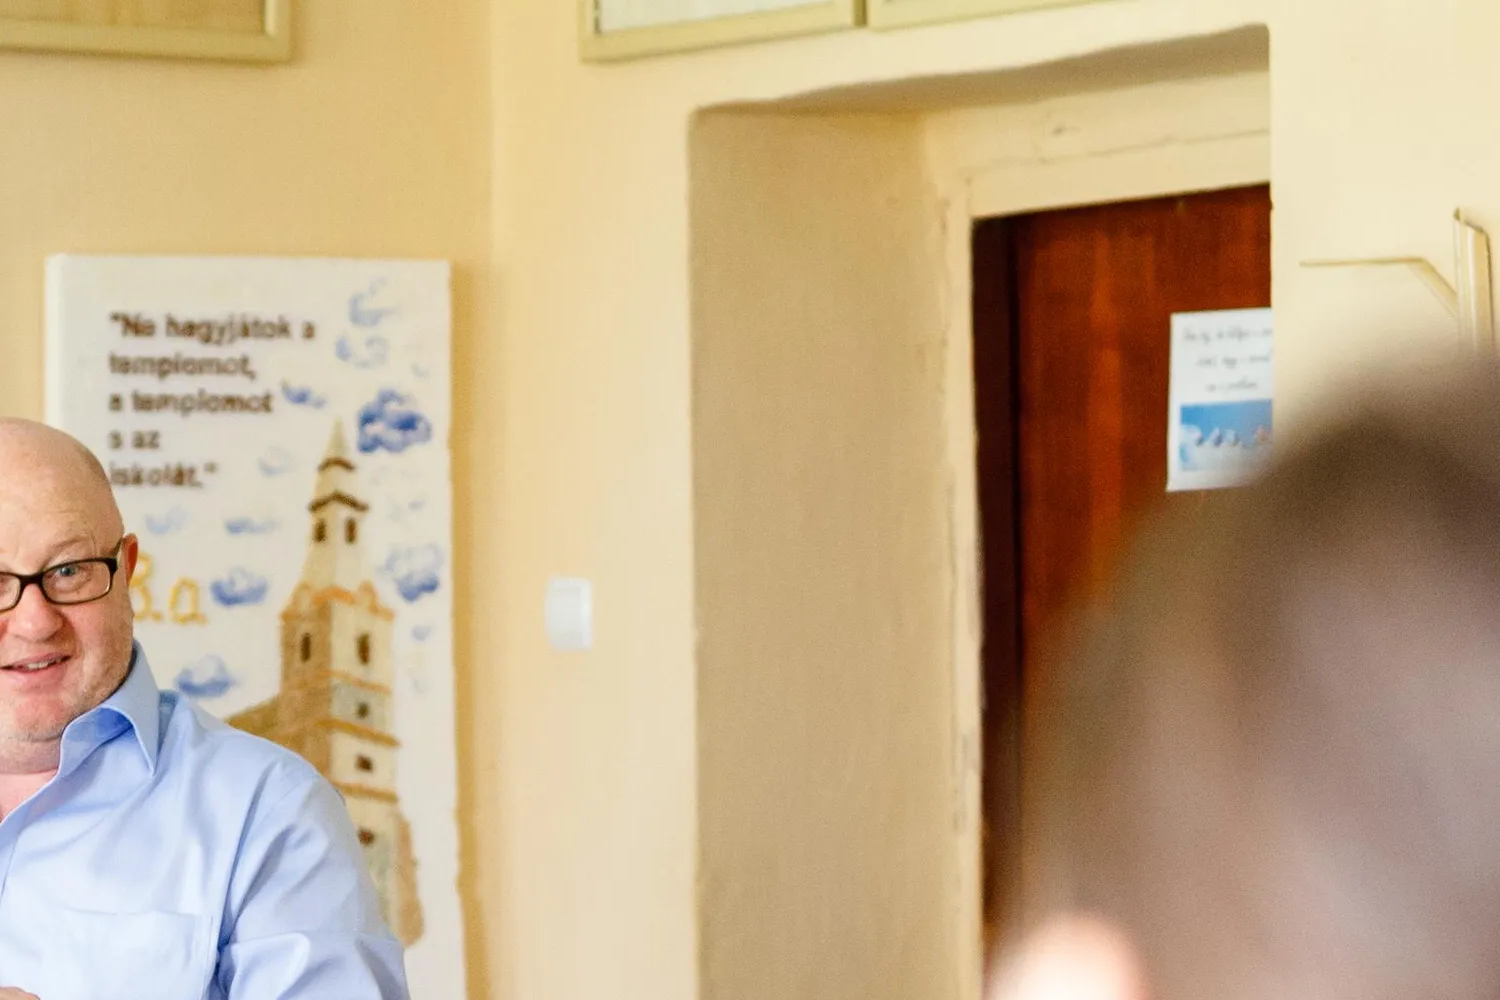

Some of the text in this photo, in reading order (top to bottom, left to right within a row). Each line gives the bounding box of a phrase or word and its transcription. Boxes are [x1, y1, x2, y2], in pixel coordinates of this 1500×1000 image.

[301, 320, 316, 339] a
[109, 351, 257, 381] templomot,
[132, 387, 272, 418] templomot
[108, 430, 161, 449] s az
